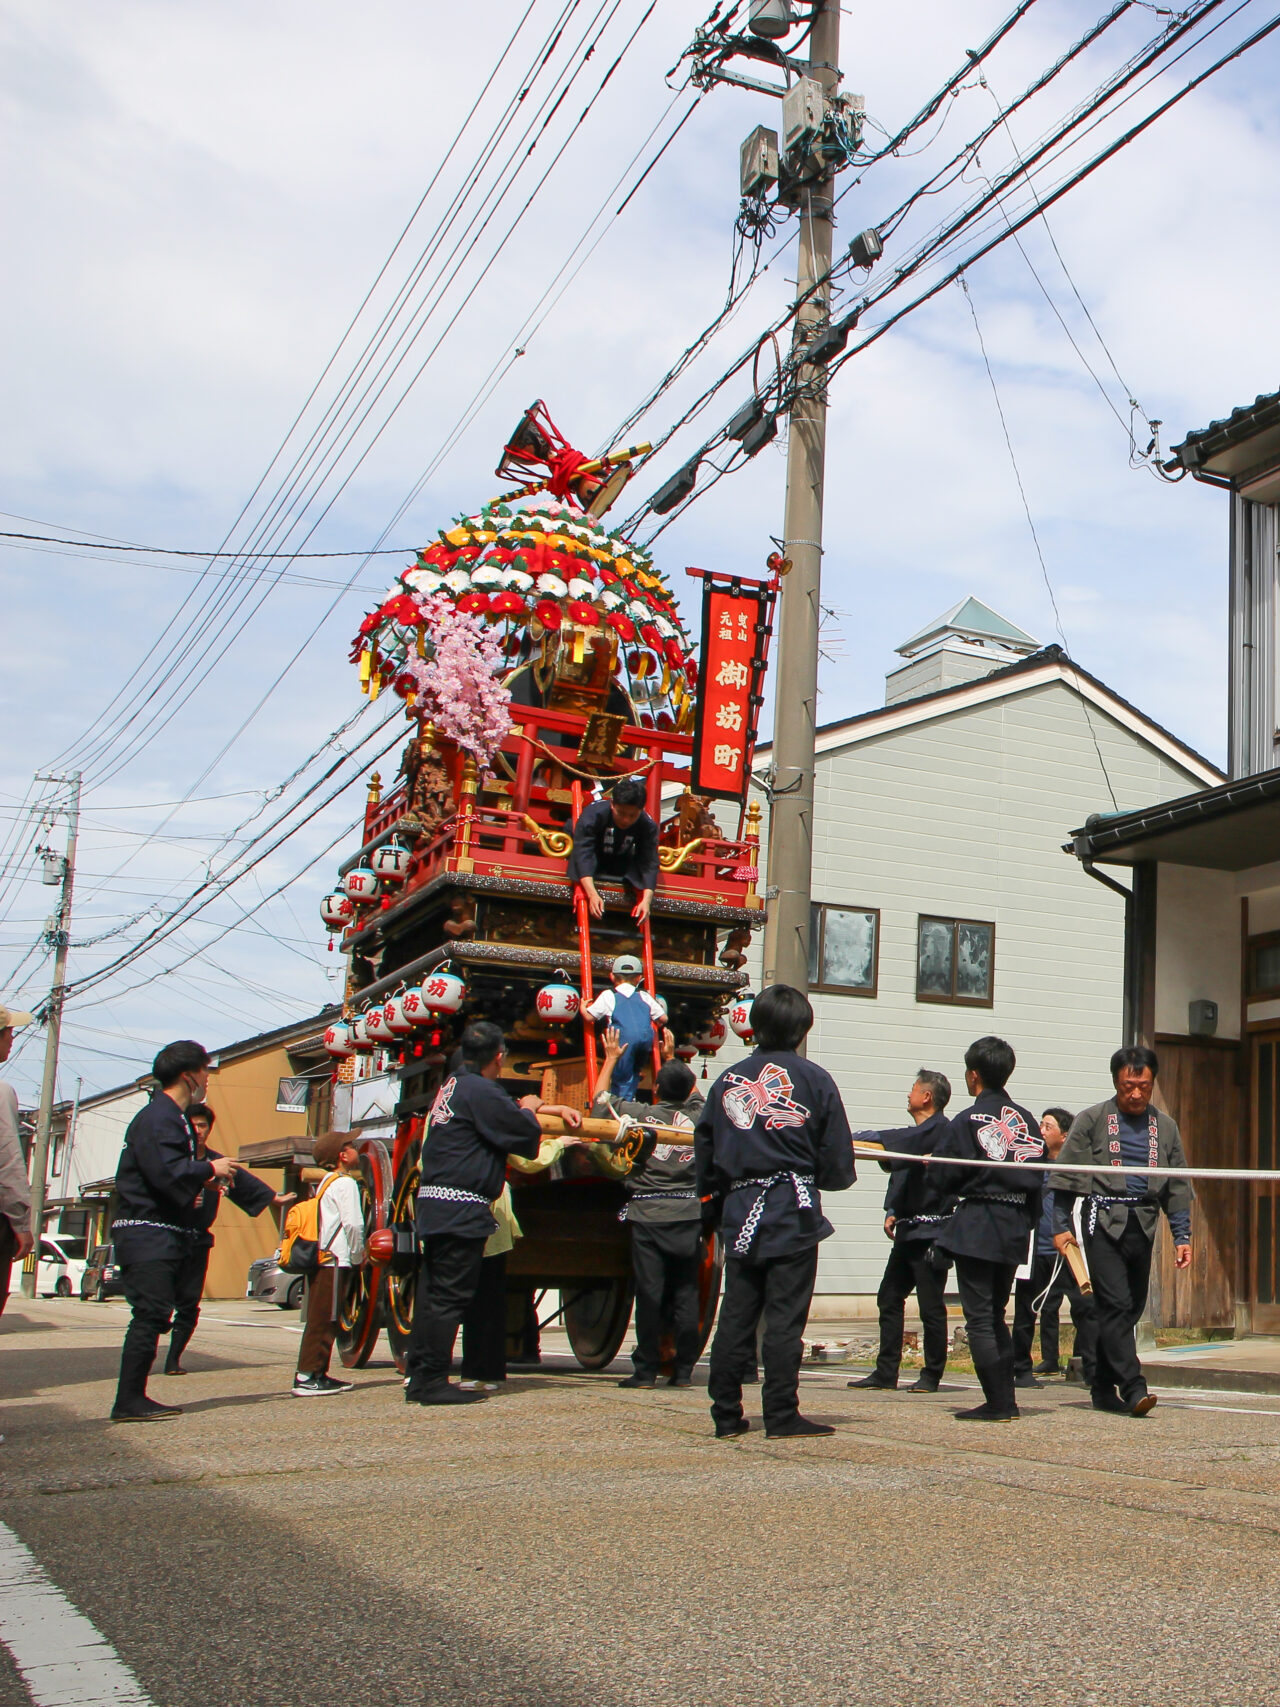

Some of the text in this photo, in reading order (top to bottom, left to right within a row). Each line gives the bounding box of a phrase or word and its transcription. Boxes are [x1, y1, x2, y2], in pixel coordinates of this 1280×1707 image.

[718, 611, 733, 640] 元祖
[737, 611, 748, 642] 曳山
[714, 659, 748, 772] 御坊町
[349, 875, 366, 891] 町
[403, 994, 420, 1012] 坊
[367, 1011, 383, 1028] 坊
[732, 1006, 747, 1023] 坊
